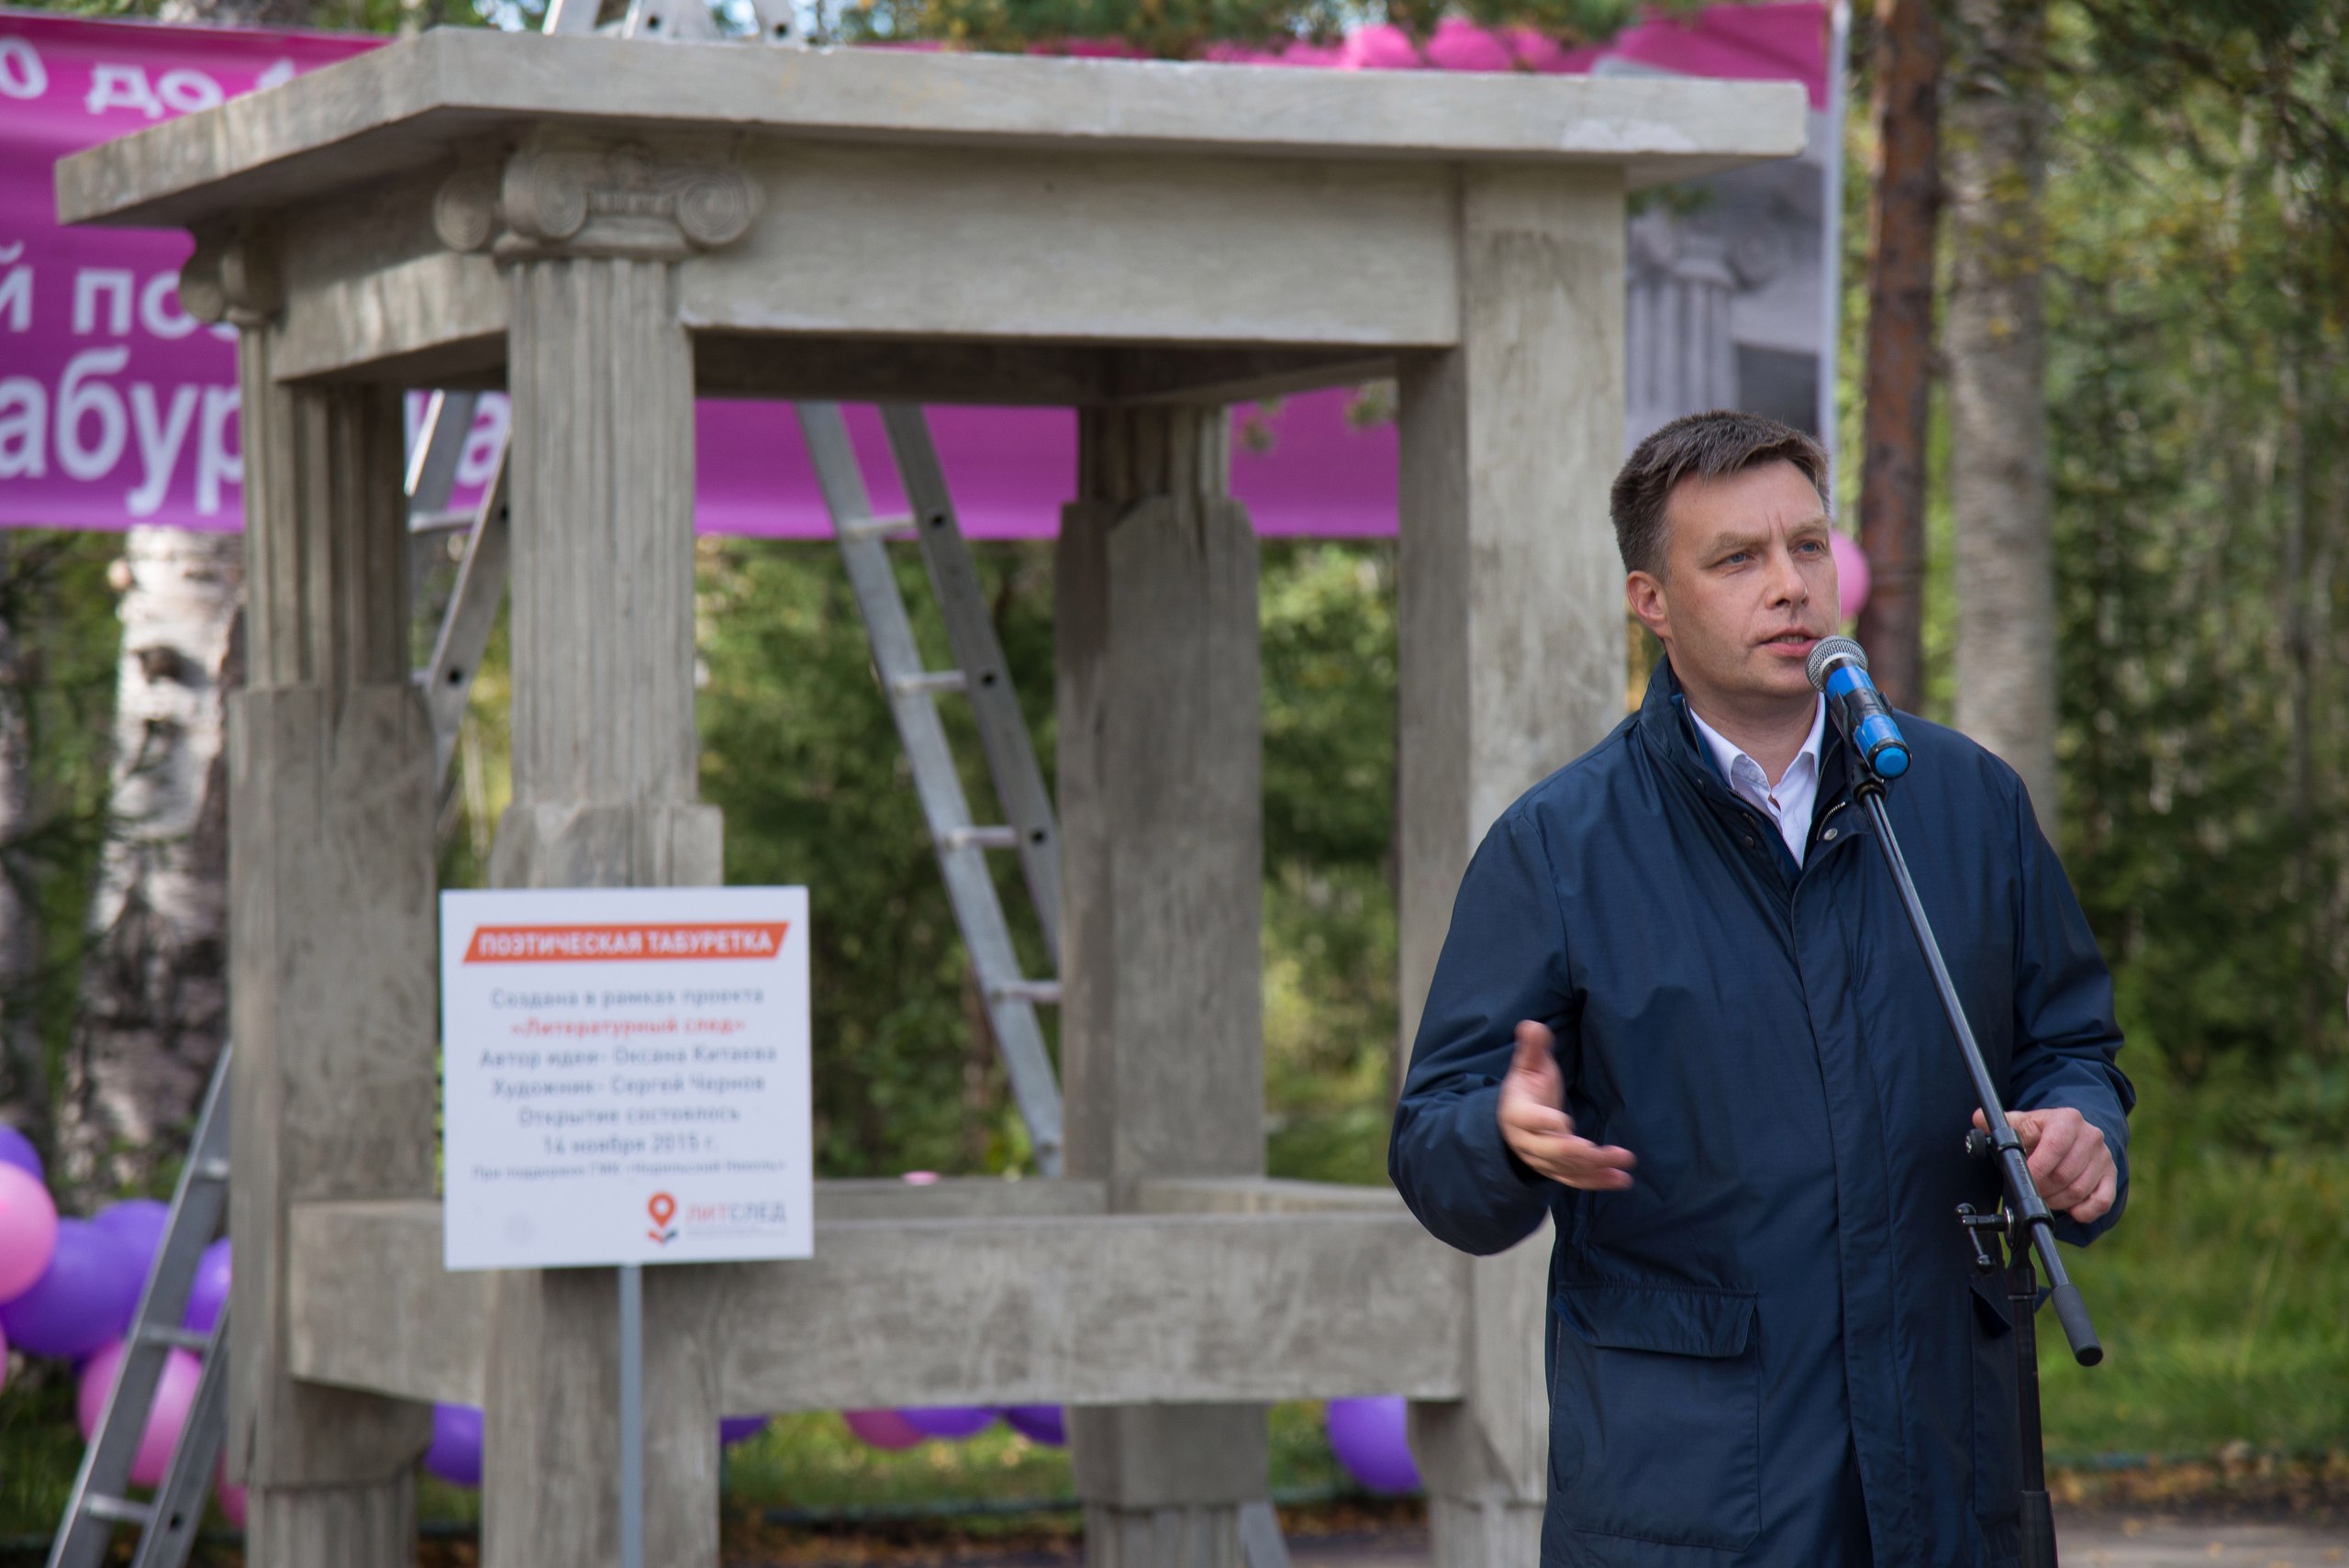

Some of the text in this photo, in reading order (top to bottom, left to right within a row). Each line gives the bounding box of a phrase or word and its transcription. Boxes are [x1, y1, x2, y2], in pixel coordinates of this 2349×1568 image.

[84, 63, 224, 118] до
[479, 930, 773, 955] ПОЭТИЧЕСКАЯ ТАБУРЕТКА
[490, 988, 763, 1009] Создана в рамках проекта
[478, 1050, 540, 1070] Автор
[612, 1045, 687, 1065] Оксана
[692, 1045, 776, 1062] Китаева
[609, 1075, 685, 1097] Сергей
[689, 1074, 765, 1095] Чернов
[518, 1106, 619, 1129] Открытие
[571, 1134, 645, 1156] ноября
[651, 1132, 699, 1154] 2015
